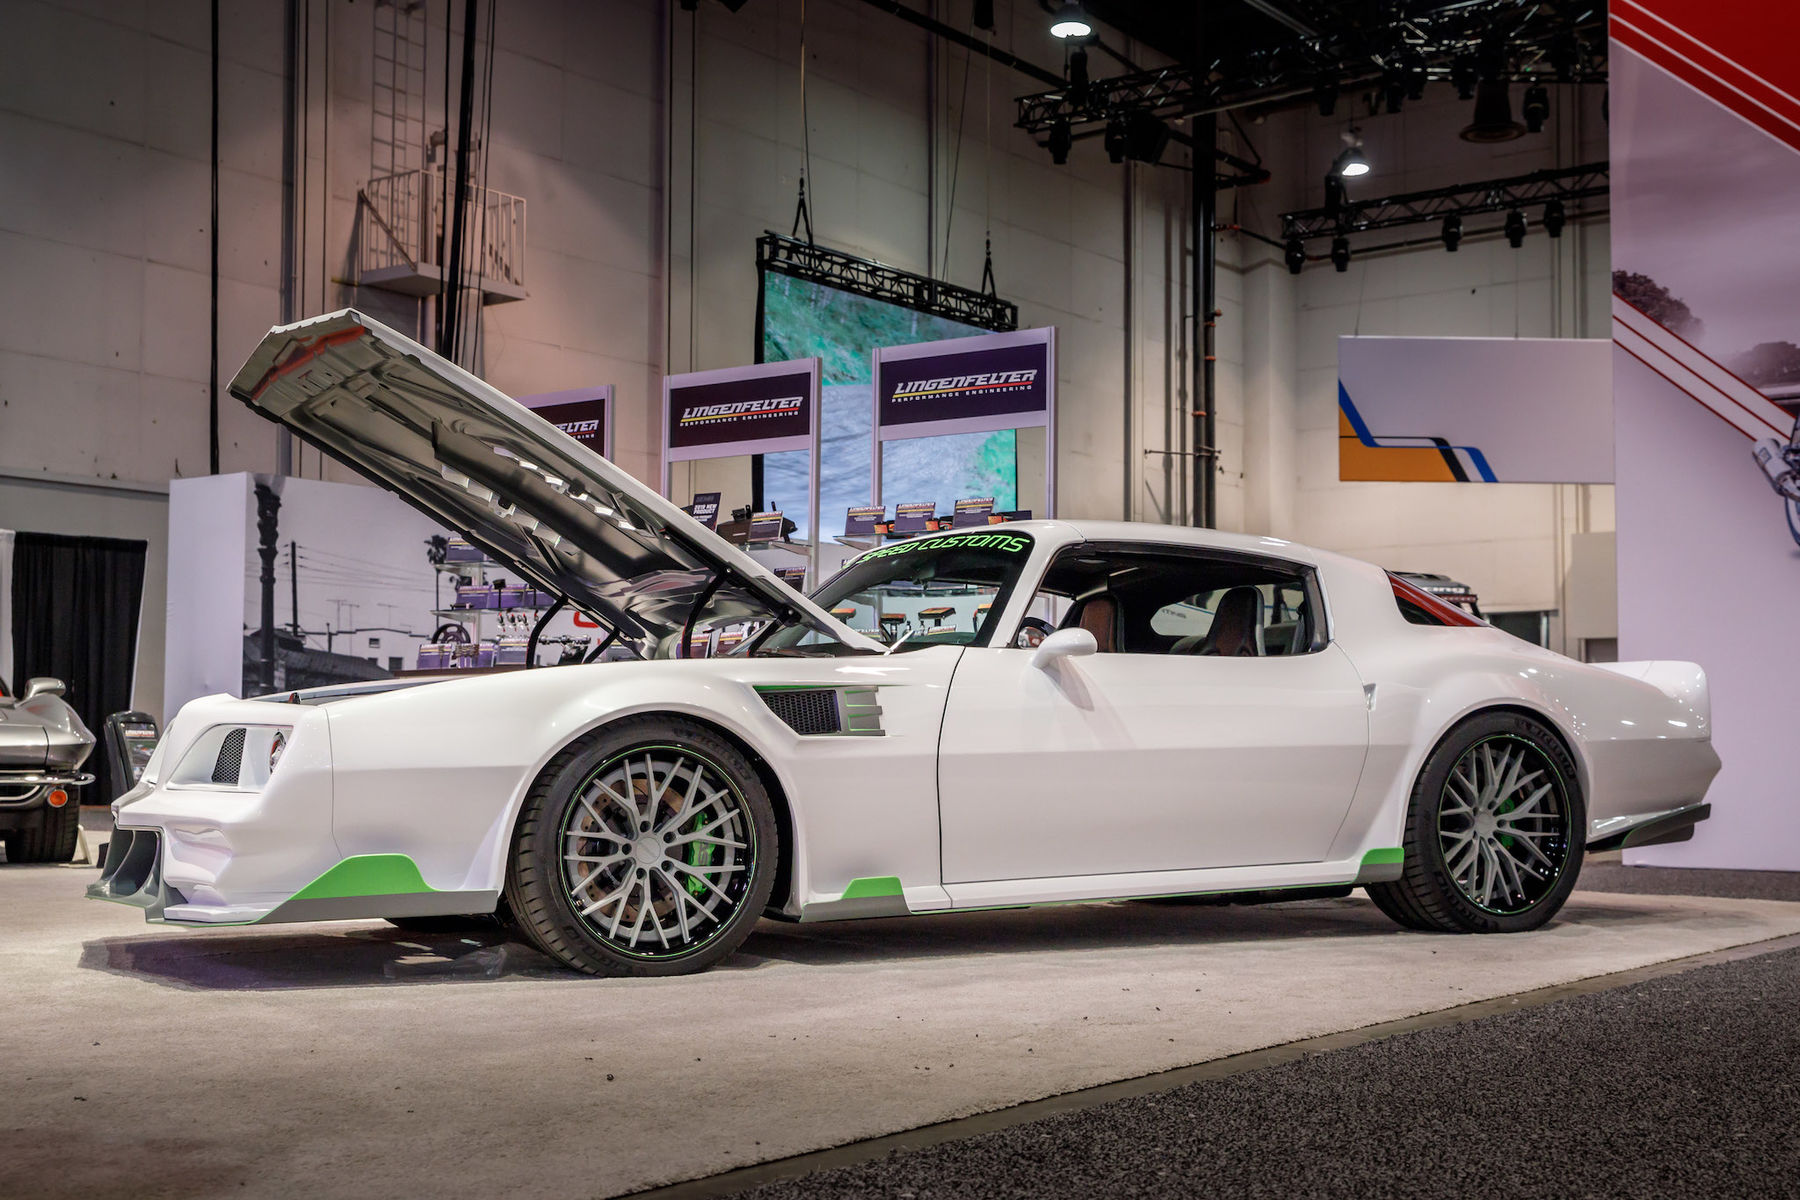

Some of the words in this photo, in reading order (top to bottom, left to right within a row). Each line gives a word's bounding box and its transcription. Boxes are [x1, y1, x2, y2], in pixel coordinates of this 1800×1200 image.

[894, 369, 1038, 394] LINGENFELTER
[892, 392, 960, 403] PERFORMANCE
[966, 384, 1032, 396] ENGINEERING
[682, 396, 804, 419] LINGENFELTER
[679, 417, 738, 427] PERFORMANCE
[742, 411, 799, 421] ENGINEERING
[918, 535, 1031, 553] CUSTOMS
